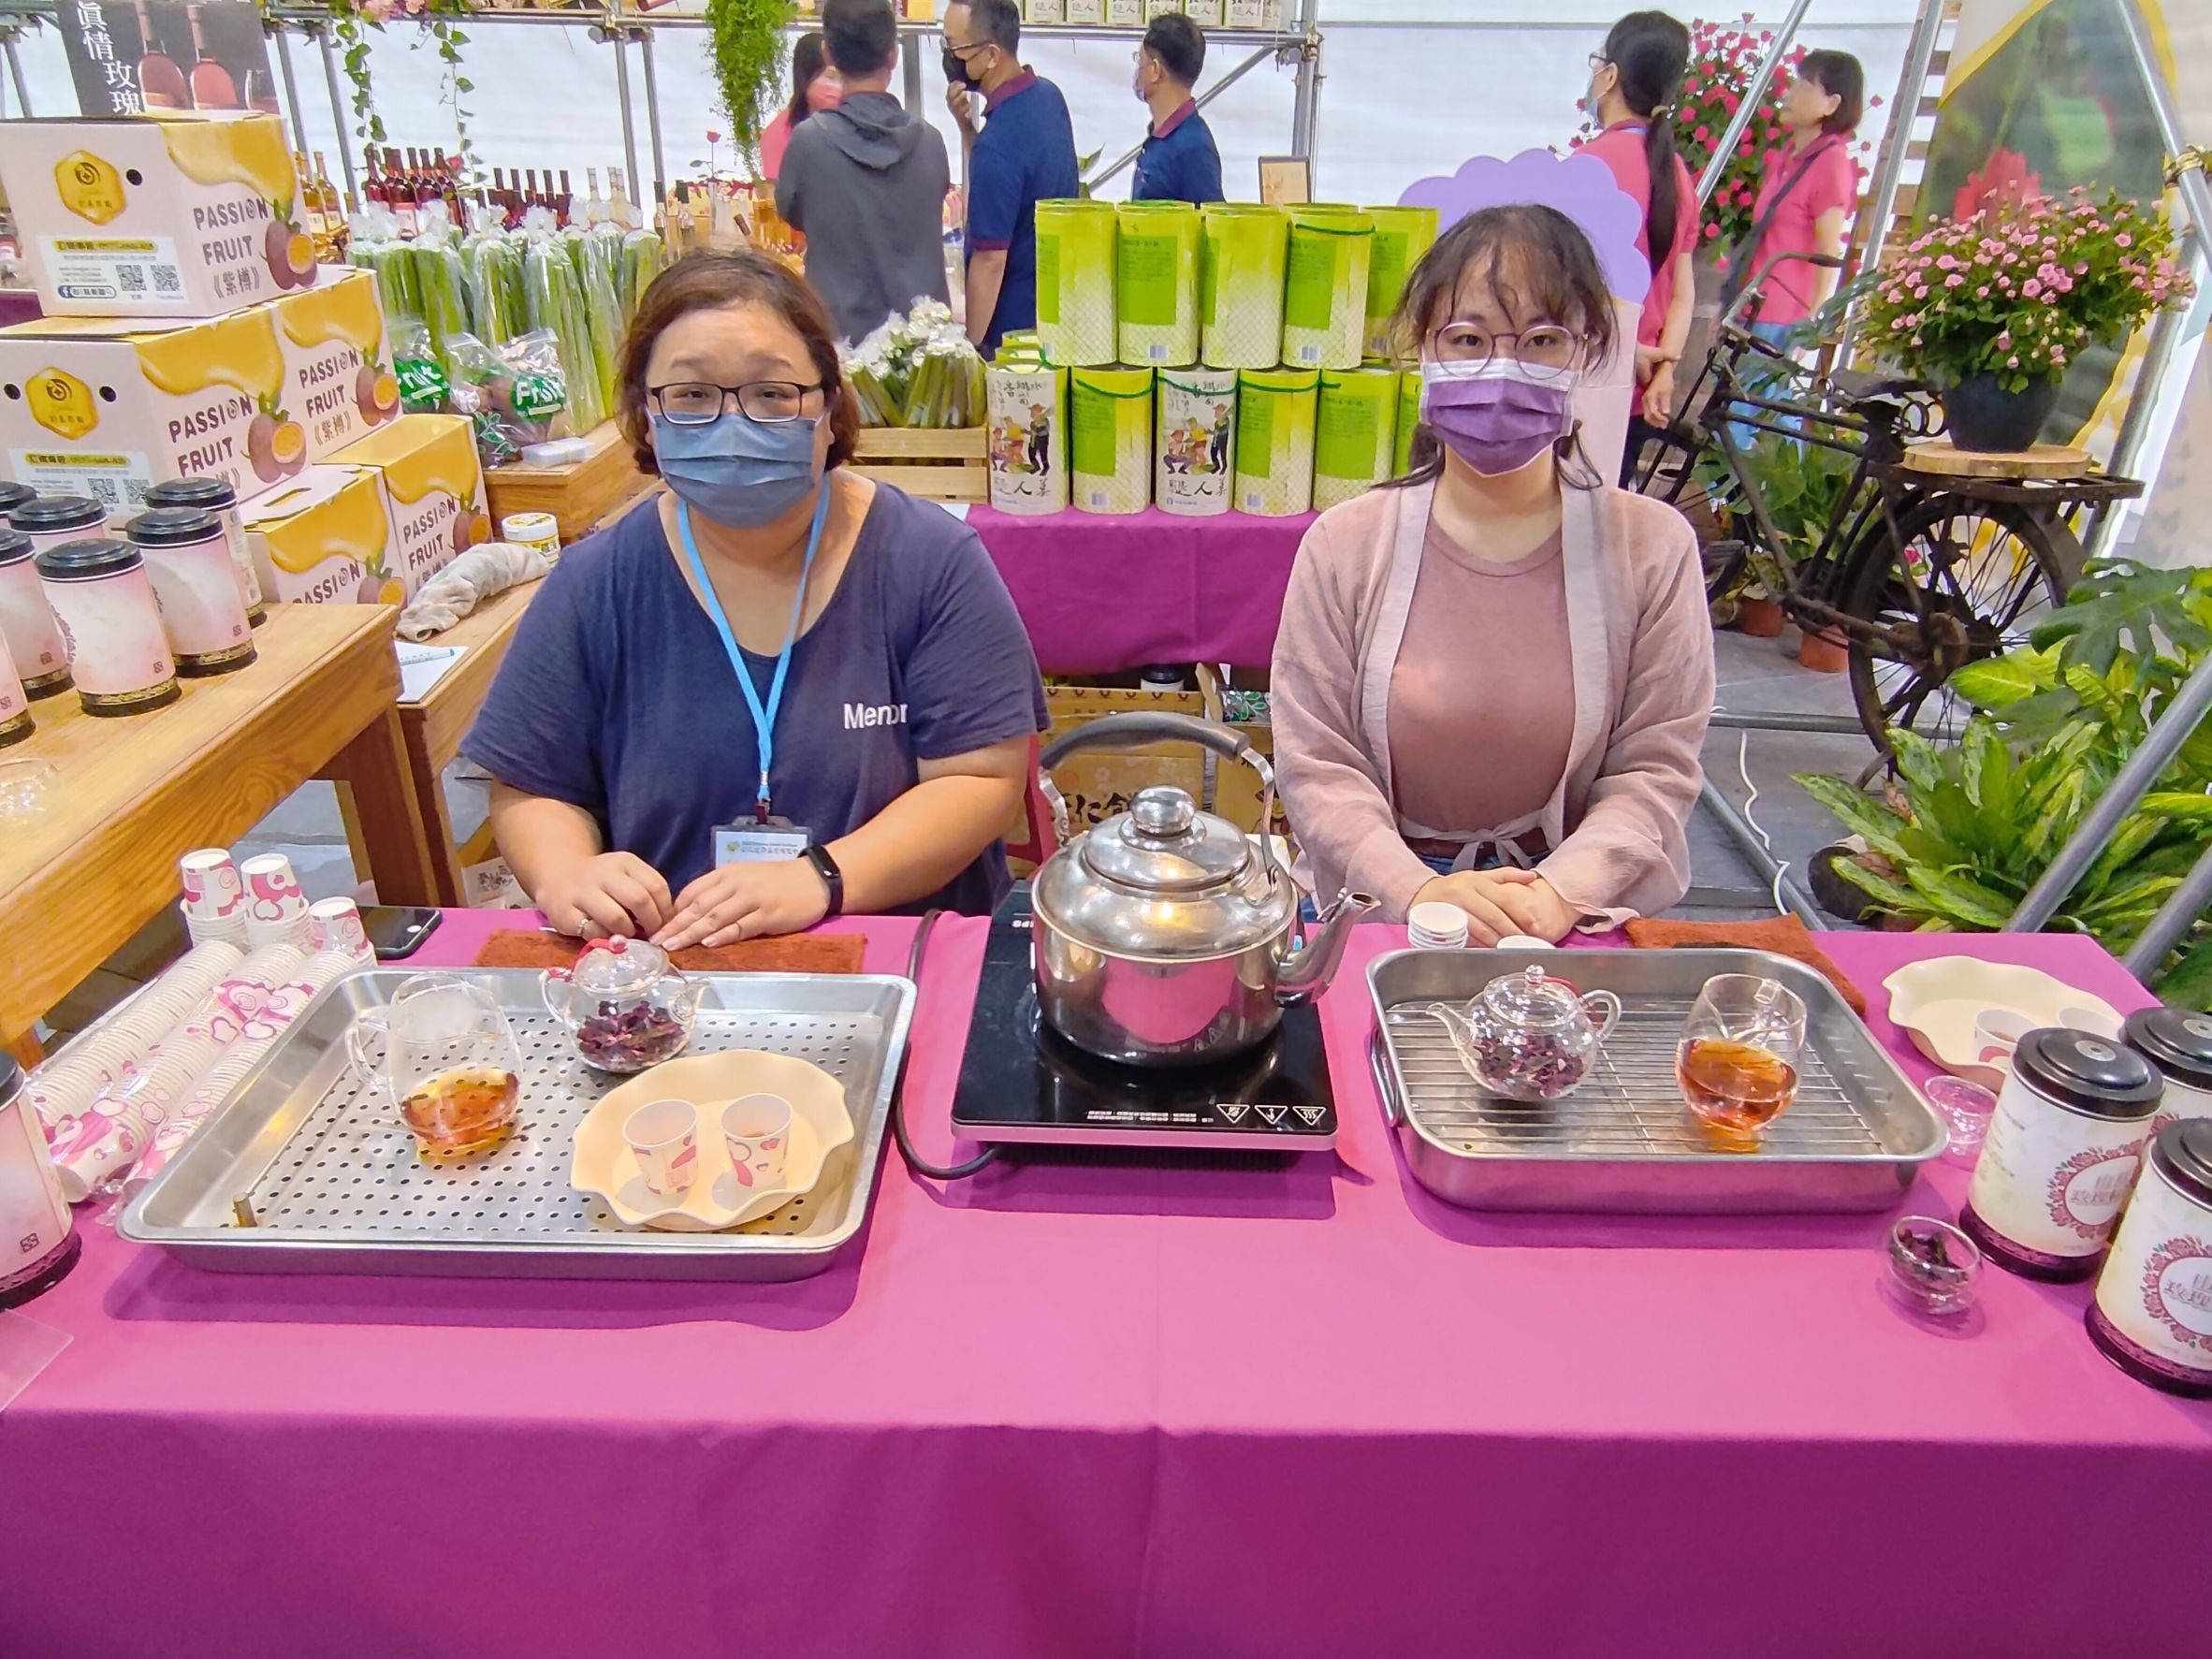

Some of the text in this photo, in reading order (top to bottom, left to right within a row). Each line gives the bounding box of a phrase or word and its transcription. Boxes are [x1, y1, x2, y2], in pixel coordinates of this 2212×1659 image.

[193, 196, 269, 230] PASSION
[202, 235, 252, 266] FRUIT
[299, 347, 359, 388] PASSION
[306, 385, 345, 418] FRUIT
[517, 378, 566, 406] Fruit
[168, 396, 253, 444] PASSION
[178, 437, 233, 477] FRUIT
[402, 497, 457, 544] PASSION
[408, 533, 444, 571] FRUIT
[292, 560, 361, 604] ASSION
